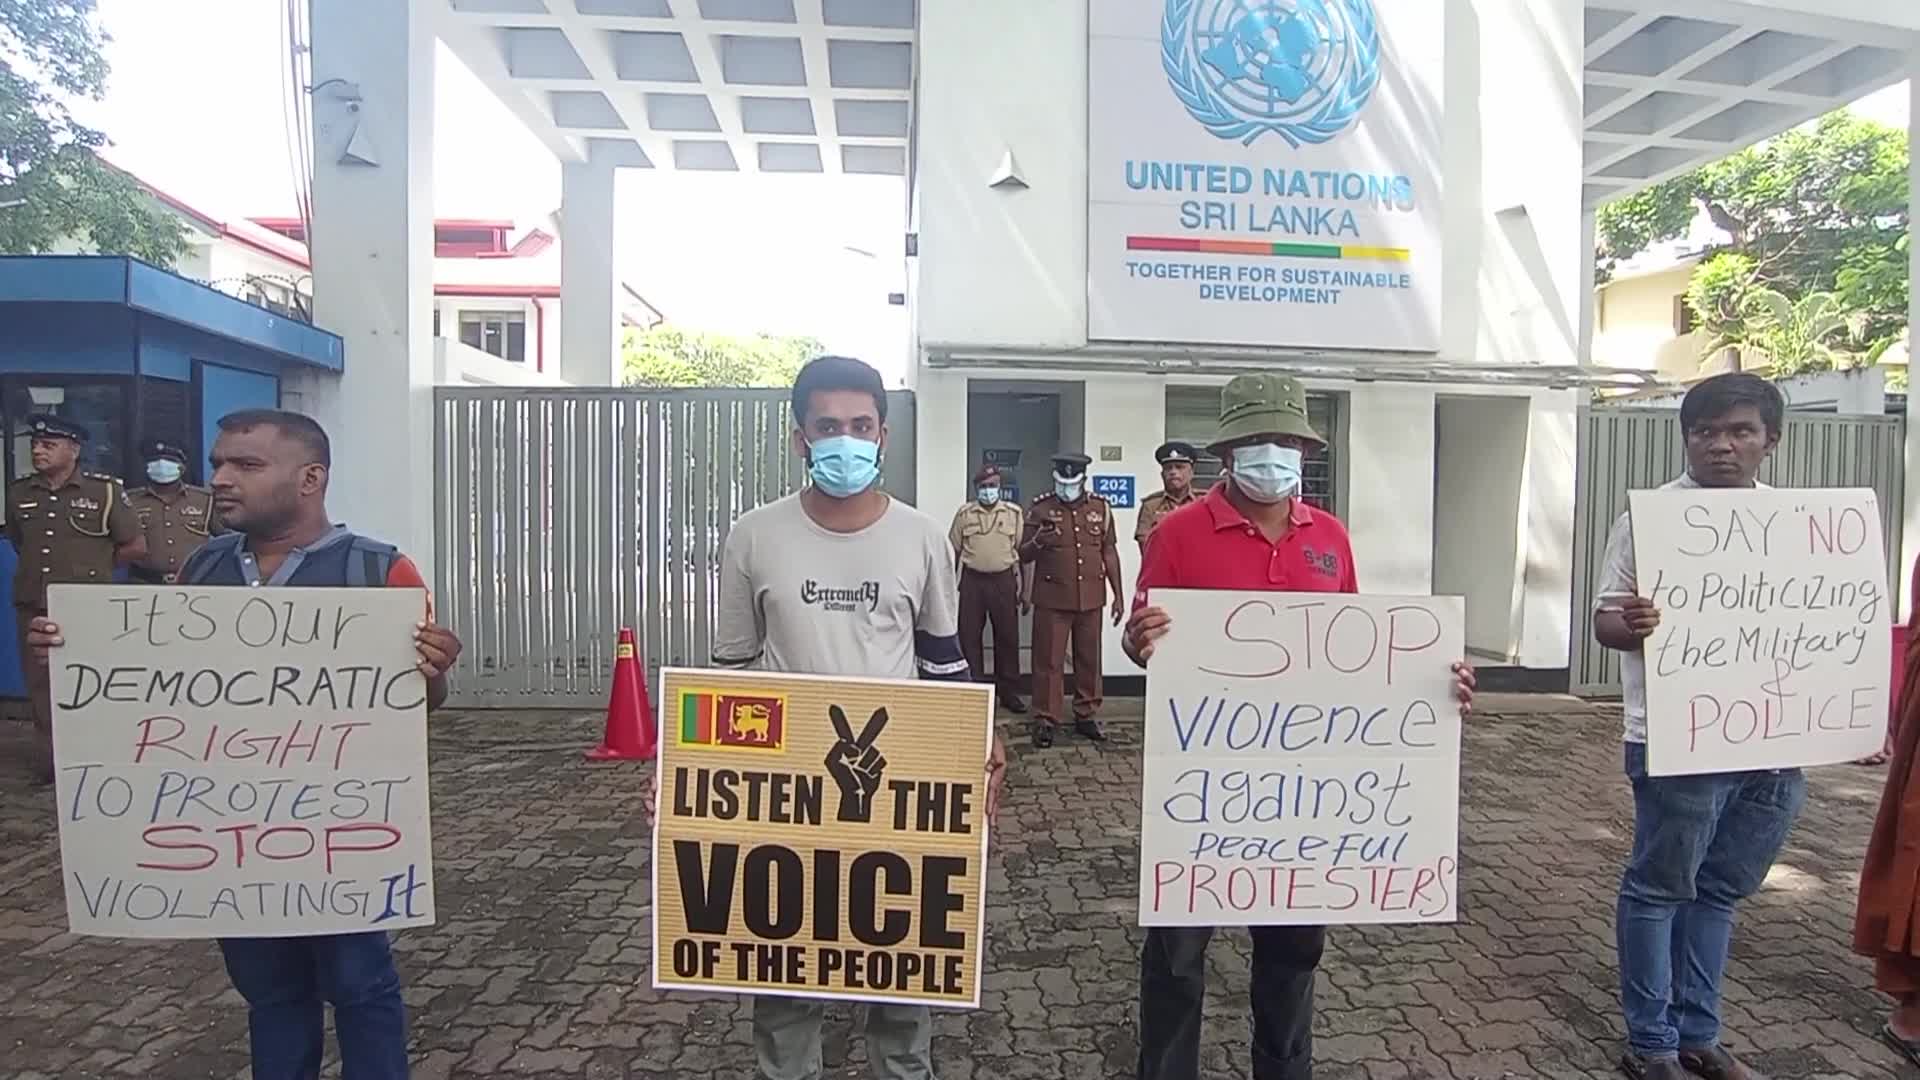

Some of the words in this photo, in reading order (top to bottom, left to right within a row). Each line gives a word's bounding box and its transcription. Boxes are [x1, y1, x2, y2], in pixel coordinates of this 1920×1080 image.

[1125, 160, 1252, 195] UNITED
[1263, 168, 1415, 211] NATIONS
[1180, 201, 1236, 231] SRI
[1249, 205, 1359, 237] LANKA
[1126, 262, 1231, 282] TOGETHER
[1237, 267, 1277, 285] FOR
[1282, 268, 1411, 289] SUSTAINABLE
[1200, 284, 1341, 305] DEVELOPMENT
[1100, 479, 1128, 490] 202
[1109, 494, 1128, 505] 04
[1678, 505, 1778, 556] SAY
[1198, 600, 1440, 685] STOP
[1657, 626, 1727, 677] the
[57, 664, 427, 710] DEMOCRATIC
[134, 716, 371, 770] RIGHT
[1688, 687, 1878, 752] POLICE
[62, 764, 133, 821] TO
[151, 771, 411, 823] PROTEST
[673, 767, 823, 826] LISTEN
[888, 780, 973, 834] THE
[1163, 763, 1412, 826] against
[136, 824, 401, 874] STOP
[73, 871, 369, 920] VIOLATING
[672, 839, 967, 950] VOICE
[1153, 856, 1456, 917] PROTESTERS
[673, 938, 721, 979] OF
[731, 942, 806, 985] THE
[817, 947, 963, 995] PEOPLE
